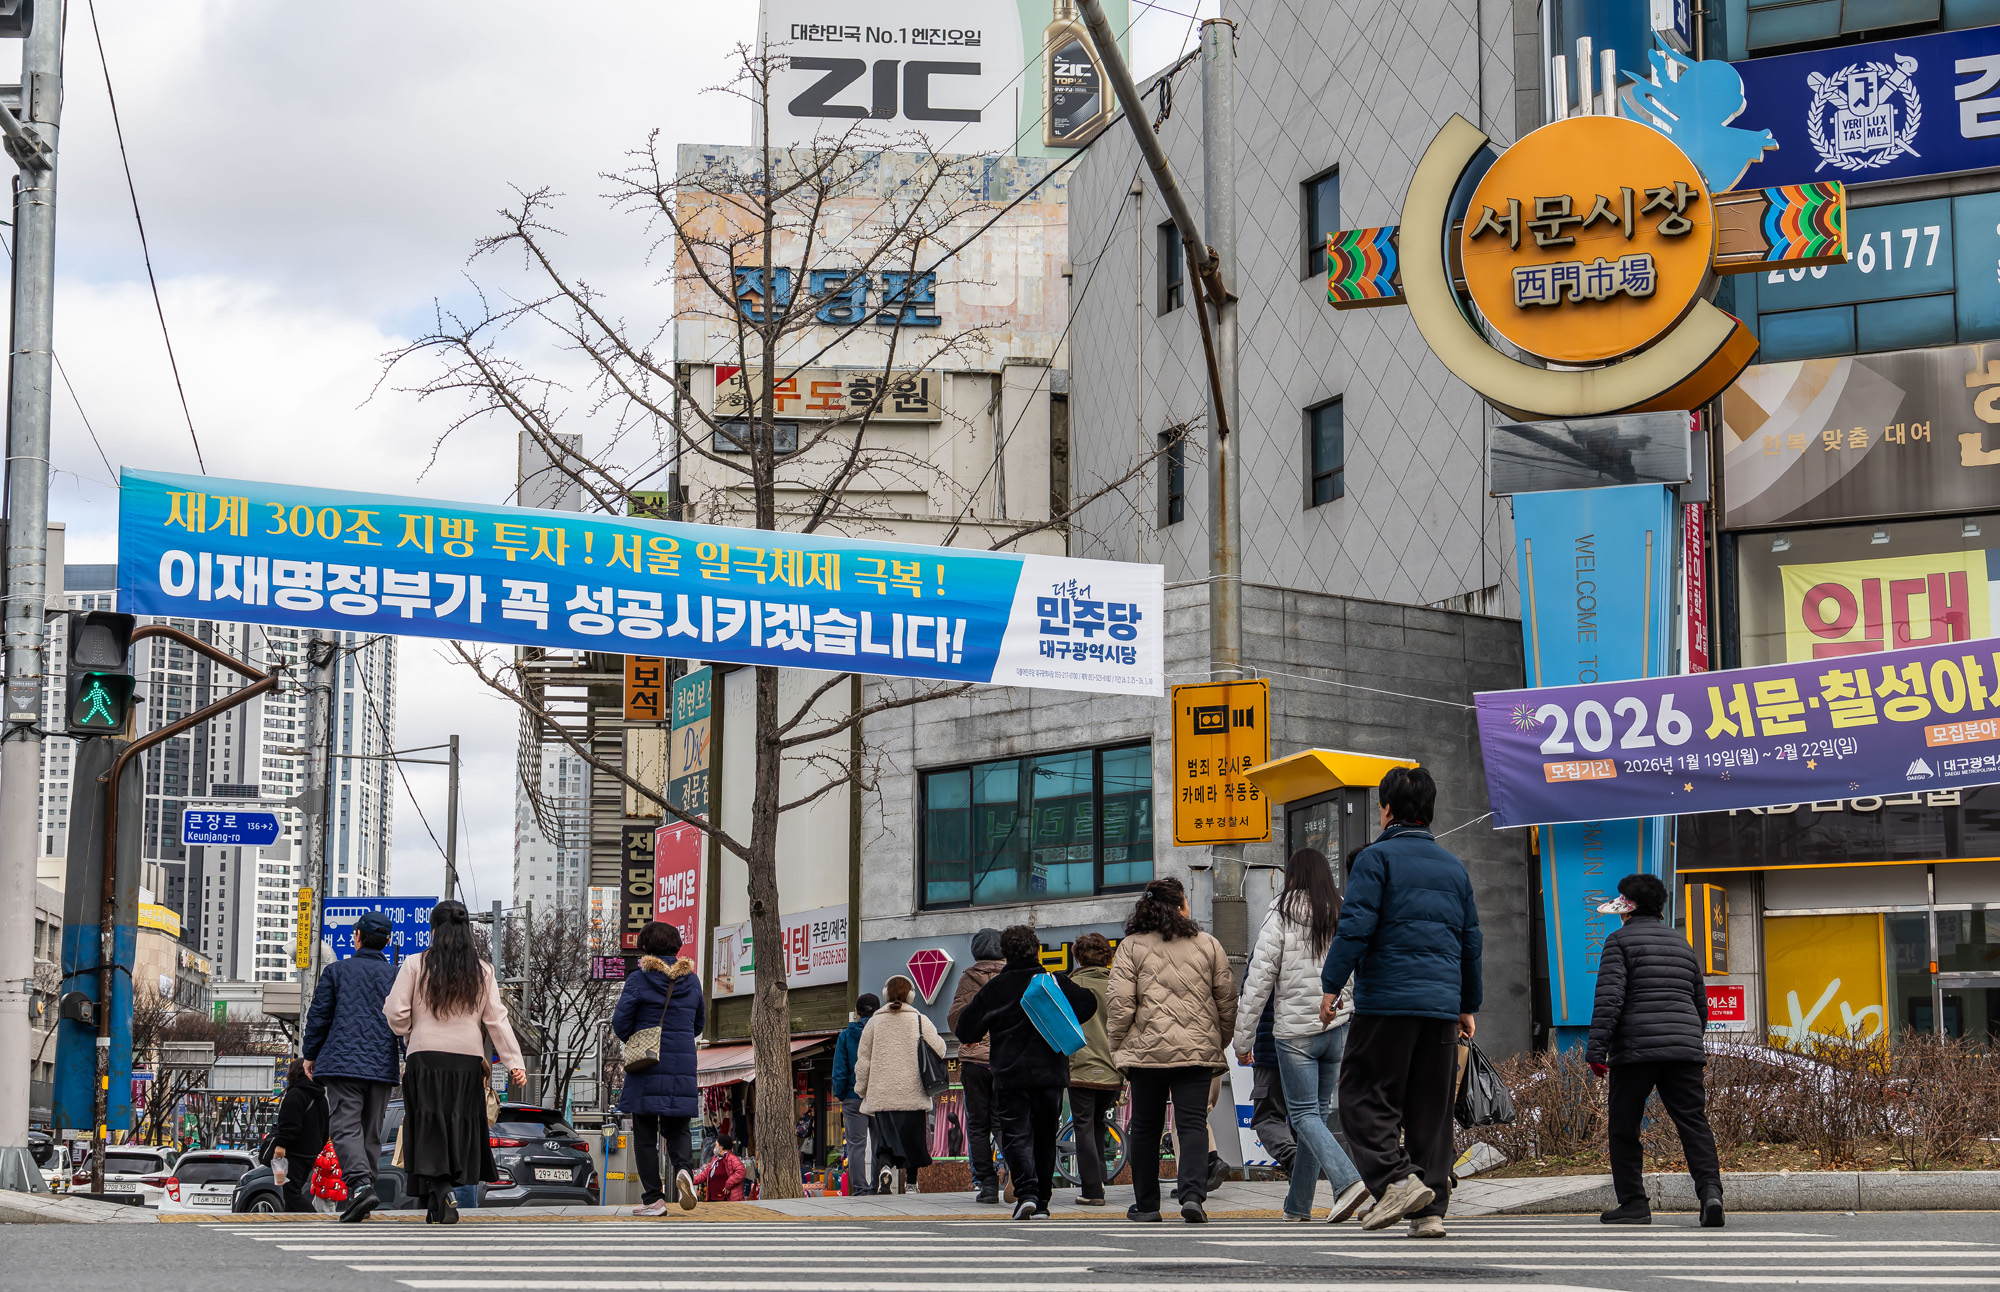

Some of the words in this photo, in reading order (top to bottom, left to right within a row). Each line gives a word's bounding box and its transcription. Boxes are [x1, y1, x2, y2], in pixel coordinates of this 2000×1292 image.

[790, 24, 861, 43] 대한민국
[865, 26, 907, 45] No.1
[911, 28, 981, 47] 엔진오일
[1054, 63, 1092, 77] ZIC
[788, 56, 982, 122] ZIC
[1842, 118, 1862, 130] VERI
[1867, 114, 1887, 127] LUX
[1867, 126, 1889, 139] MEA
[1843, 130, 1862, 142] TAS
[1469, 181, 1700, 251] 서문시장
[1516, 259, 1651, 303] 西門市場
[734, 266, 942, 327] 전당포
[1761, 431, 1809, 457] 한복
[1822, 426, 1870, 452] 맞춤
[1884, 420, 1932, 445] 대여
[162, 490, 249, 538] 재계
[265, 501, 383, 547] 300조
[396, 512, 479, 558] 지방
[491, 521, 570, 566] 투자
[606, 533, 682, 577] 서울
[696, 542, 841, 591] 일극체제
[854, 556, 923, 598] 극복
[1051, 578, 1092, 600] 더불어
[1574, 534, 1598, 643] WELCOME
[157, 548, 487, 624] 이재명정부가
[501, 578, 550, 631] 꼭
[564, 583, 967, 665] 성공시키겠습니다!
[1036, 596, 1143, 642] 민주당
[1038, 640, 1138, 666] 대구광역시당
[1578, 655, 1599, 684] TO
[1534, 693, 1693, 755] 2026
[1704, 651, 2000, 740] 서문·칠성야
[1932, 720, 1998, 743] 모집분야
[1188, 758, 1210, 778] 범죄
[1551, 760, 1611, 780] 모집기간
[1623, 756, 1674, 773] 2026년
[1677, 753, 1700, 771] 1월
[1704, 748, 1759, 768] 19일(월)
[1774, 743, 1799, 761] 2월
[1801, 737, 1858, 757] 22일(일)
[1182, 784, 1218, 805] 카메라
[1224, 782, 1260, 803] 작동중
[188, 813, 238, 831] 큰장로
[247, 822, 261, 831] 136
[268, 822, 273, 831] 2
[1194, 816, 1249, 829] 중부경찰서
[187, 831, 241, 843] Keunjang-ro
[627, 832, 654, 931] 전당포
[299, 891, 311, 900] CCTV
[812, 917, 847, 944] 주문/제작
[1706, 996, 1738, 1009] 에스원
